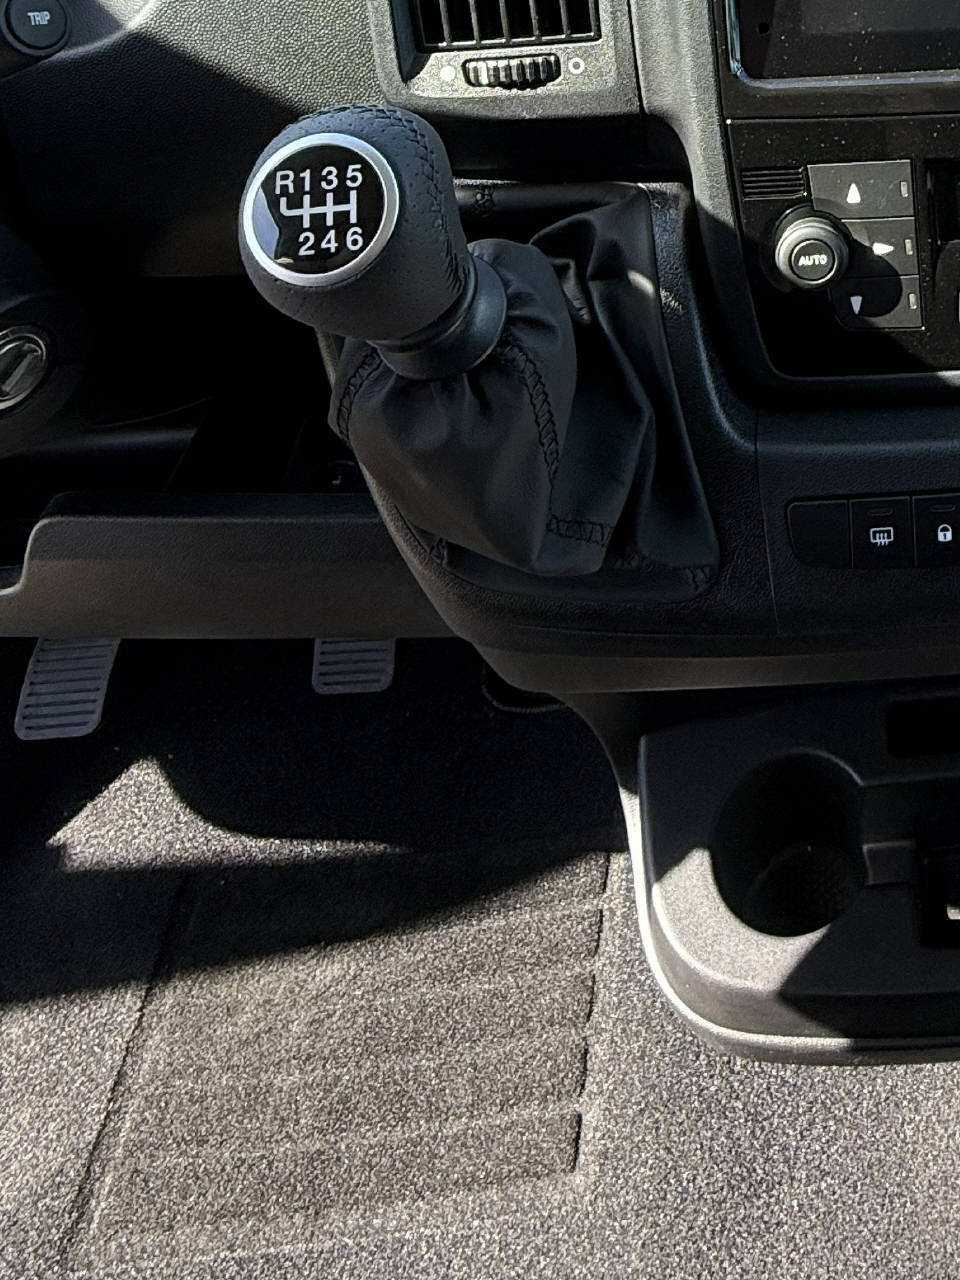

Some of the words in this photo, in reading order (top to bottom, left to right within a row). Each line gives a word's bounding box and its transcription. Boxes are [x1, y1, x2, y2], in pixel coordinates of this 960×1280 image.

[27, 11, 50, 26] TRIP
[275, 170, 295, 195] R
[300, 169, 311, 192] 1
[320, 166, 338, 190] 3
[346, 164, 363, 188] 5
[298, 231, 315, 256] 2
[320, 229, 339, 253] 4
[346, 227, 364, 251] 6
[798, 254, 828, 266] AUTO
